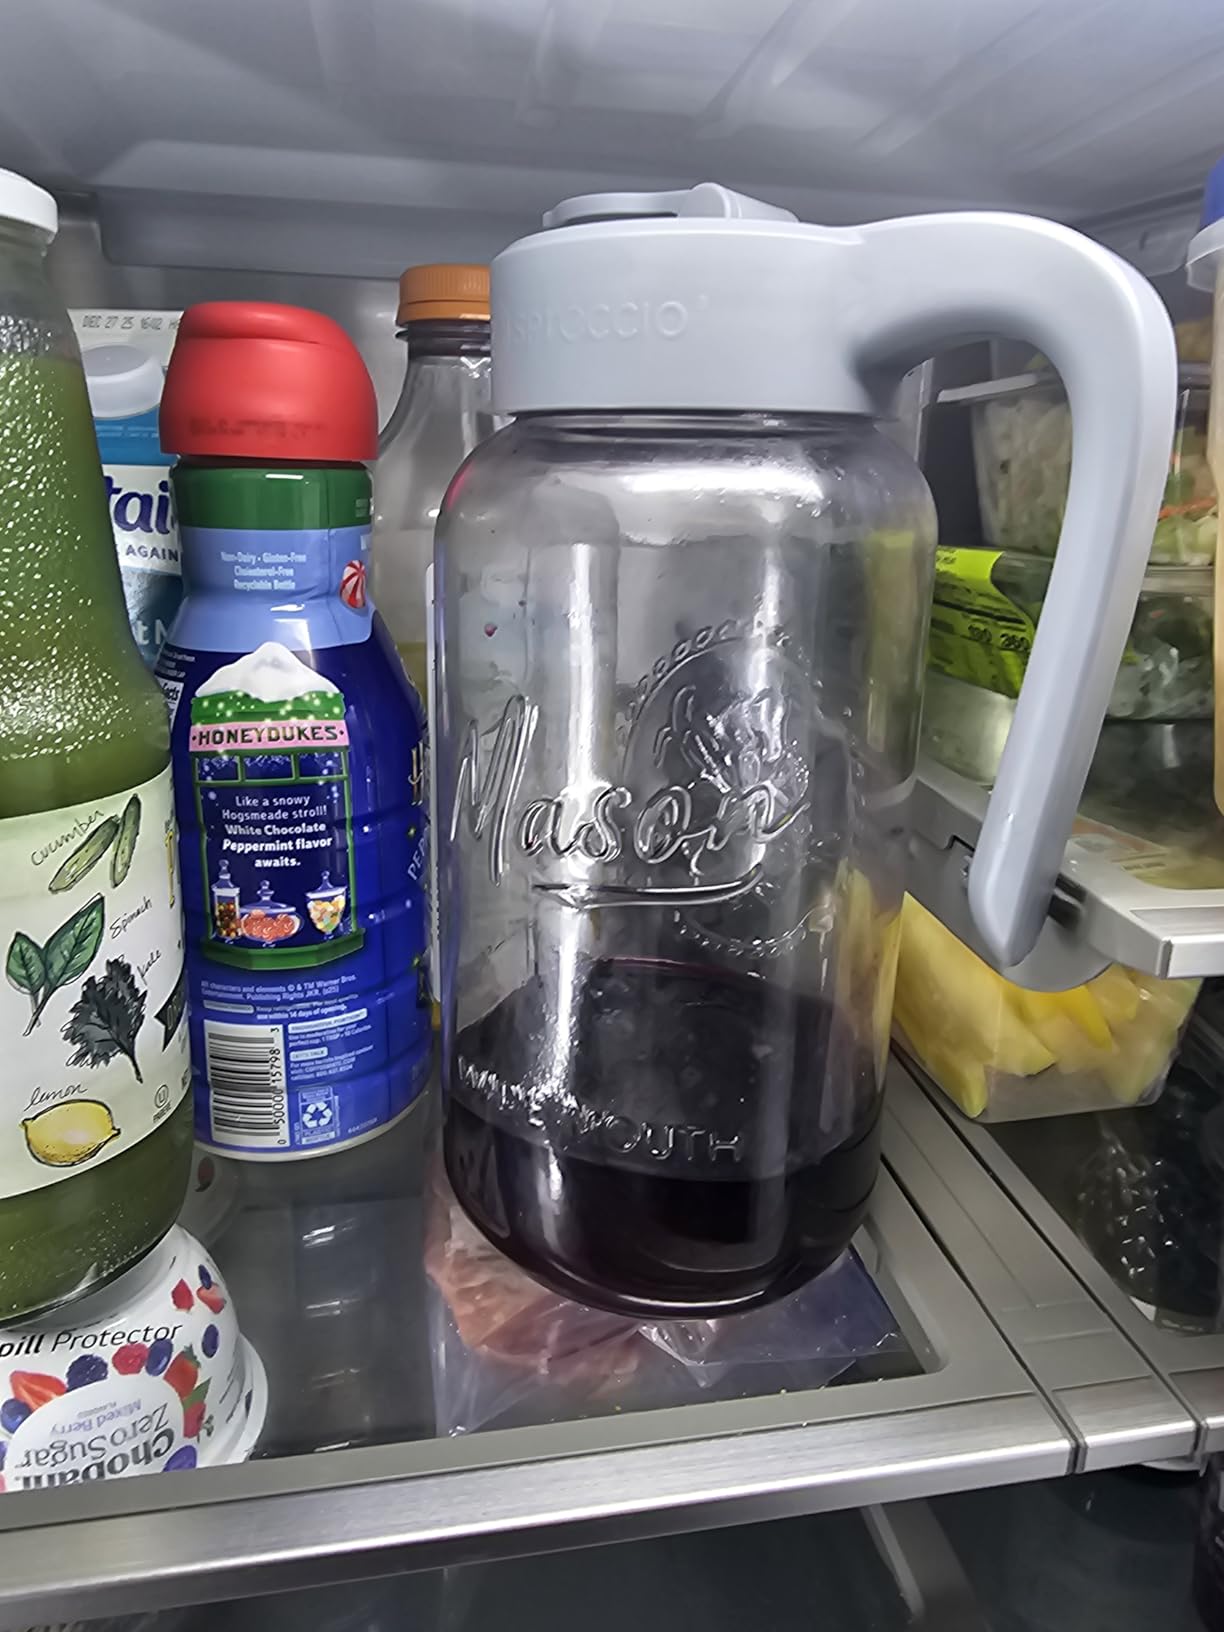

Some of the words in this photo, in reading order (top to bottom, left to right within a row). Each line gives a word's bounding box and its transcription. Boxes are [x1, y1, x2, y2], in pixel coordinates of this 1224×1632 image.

[126, 544, 179, 562] AGAIN
[198, 726, 338, 746] HONEYDUKES
[235, 795, 259, 807] Like
[262, 798, 270, 806] a
[273, 795, 310, 807] snowy
[222, 808, 289, 823] Hogsmeade
[291, 805, 328, 819] stroll!
[30, 809, 105, 867] Cucumber
[225, 824, 262, 836] White
[263, 822, 327, 836] Chocolate
[222, 838, 294, 854] Peppermint
[295, 836, 333, 850] flavor
[254, 856, 301, 868] awaits.
[269, 1048, 282, 1083] 15798
[51, 1323, 183, 1353] Protector
